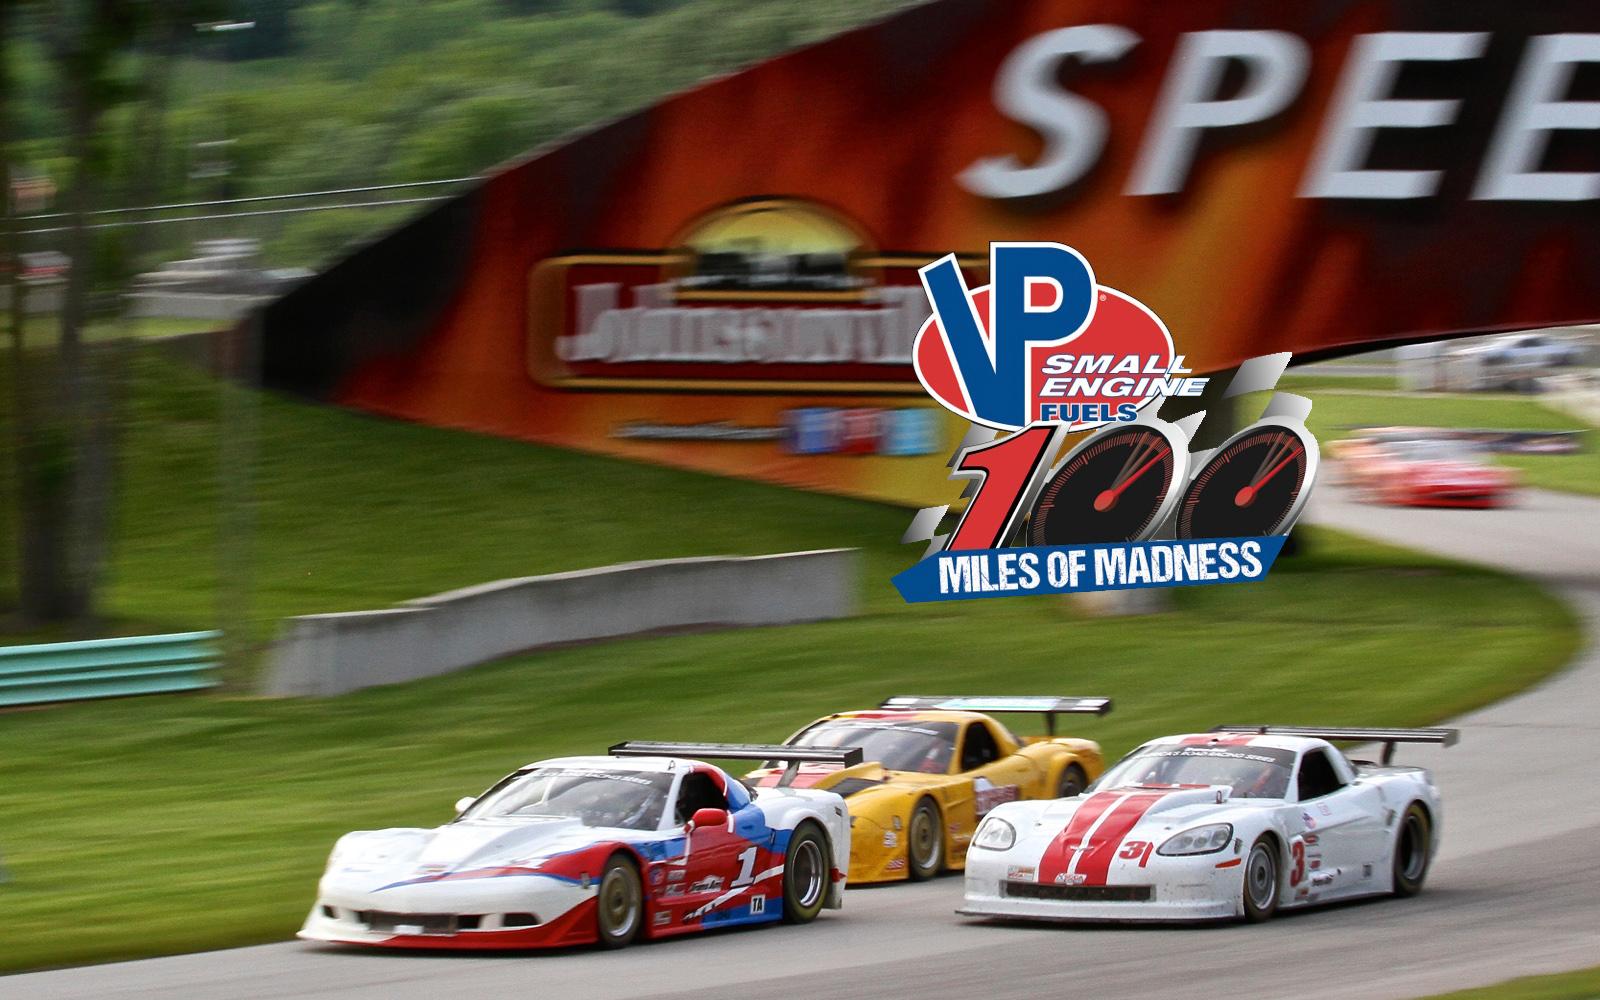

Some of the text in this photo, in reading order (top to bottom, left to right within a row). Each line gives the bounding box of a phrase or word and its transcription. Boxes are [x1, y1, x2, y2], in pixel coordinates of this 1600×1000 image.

[955, 23, 1600, 201] SPEE
[731, 847, 757, 888] 1
[1290, 841, 1305, 888] 3
[752, 898, 763, 912] TA
